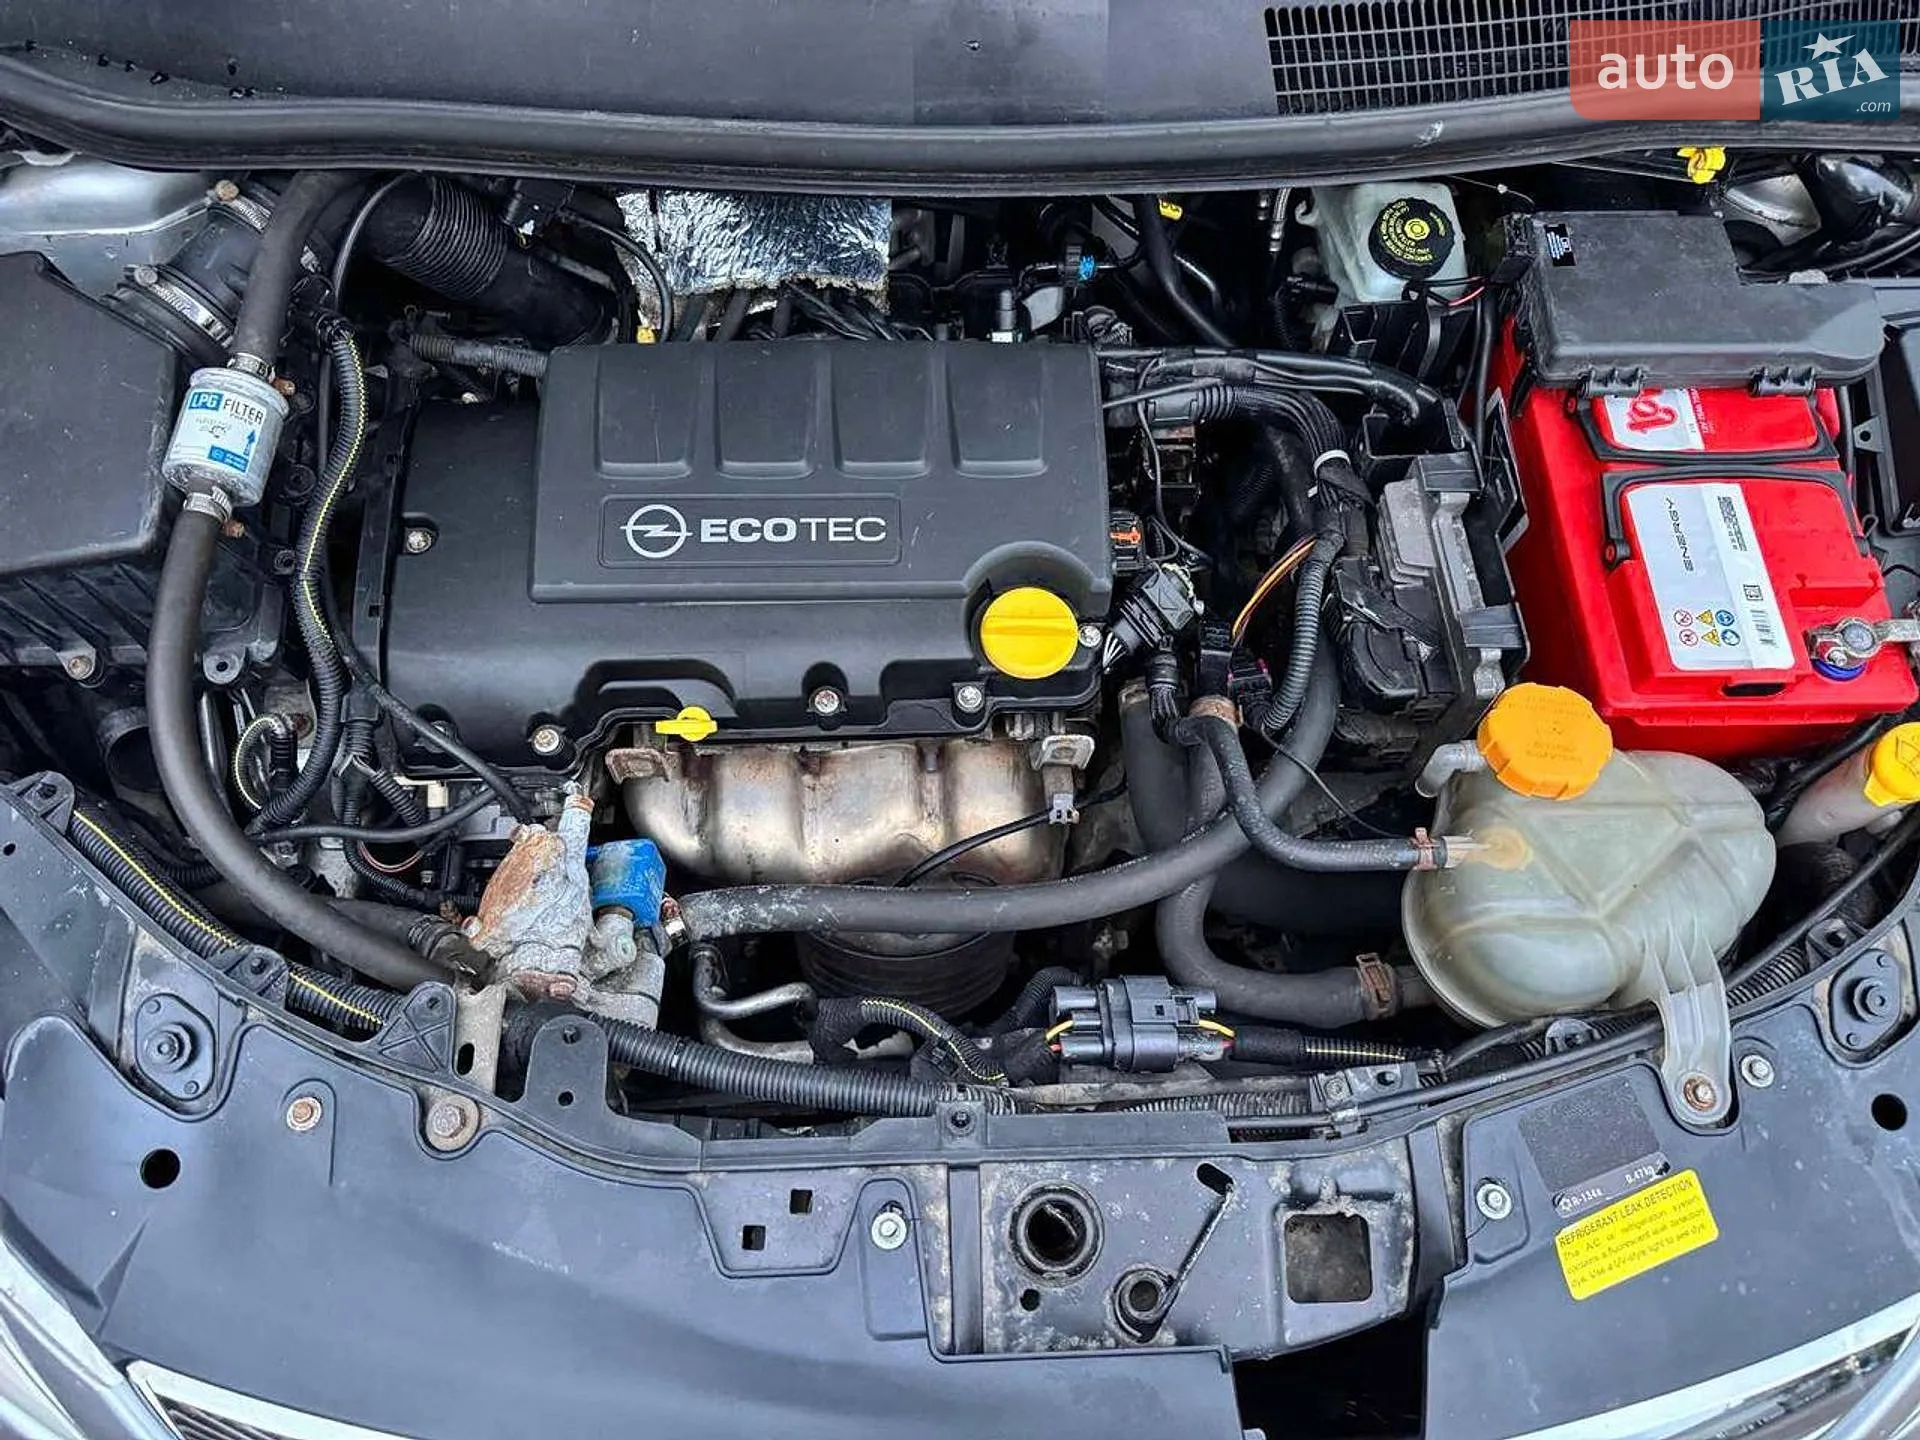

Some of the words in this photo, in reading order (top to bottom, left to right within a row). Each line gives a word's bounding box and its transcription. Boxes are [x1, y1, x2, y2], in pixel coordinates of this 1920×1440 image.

[192, 393, 219, 408] LPG
[223, 398, 265, 425] FILTER
[700, 517, 887, 543] ECOTEC
[1665, 496, 1695, 573] ENERGY
[1558, 1211, 1619, 1248] REFRIGERANT
[1619, 1201, 1643, 1219] LEAK
[1643, 1178, 1694, 1209] DETECTION
